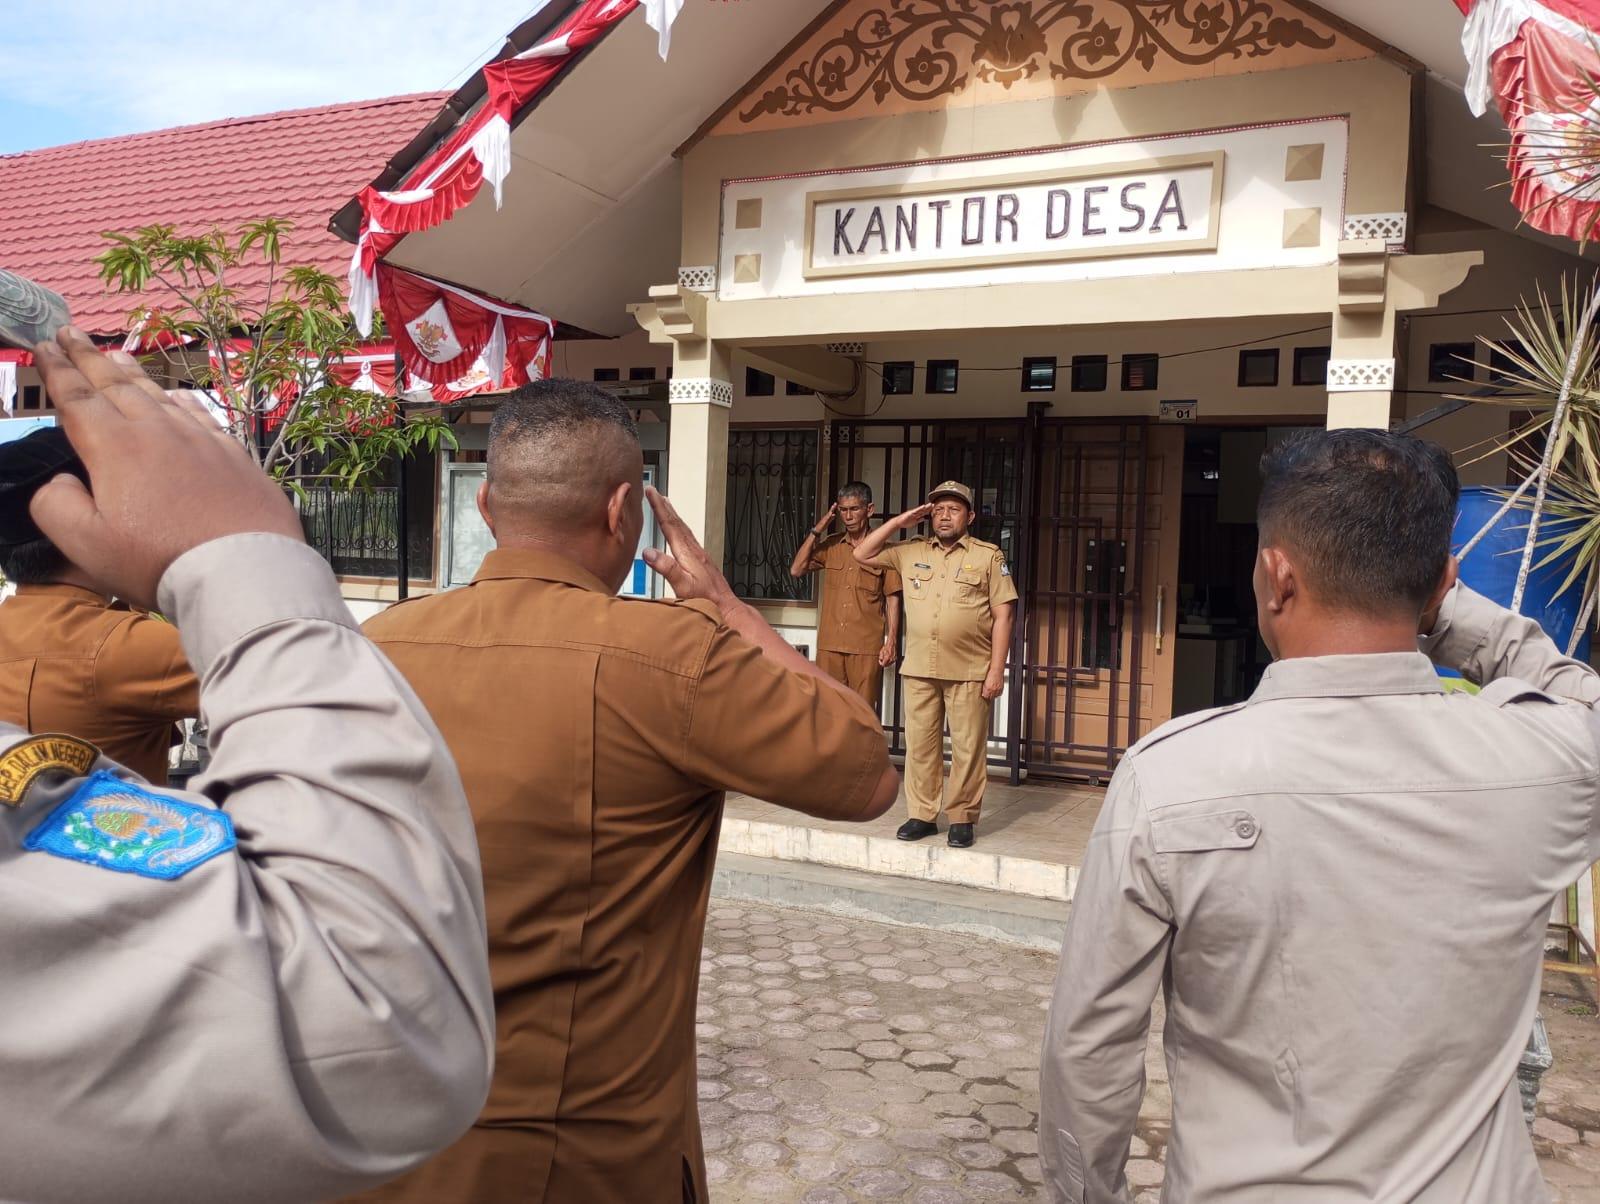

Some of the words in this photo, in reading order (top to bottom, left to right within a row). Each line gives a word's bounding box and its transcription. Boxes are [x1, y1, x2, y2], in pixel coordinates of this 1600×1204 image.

[833, 193, 1021, 256] KANTOR
[1045, 178, 1188, 240] DESA
[1176, 409, 1190, 418] 01
[50, 742, 92, 772] NEGERI
